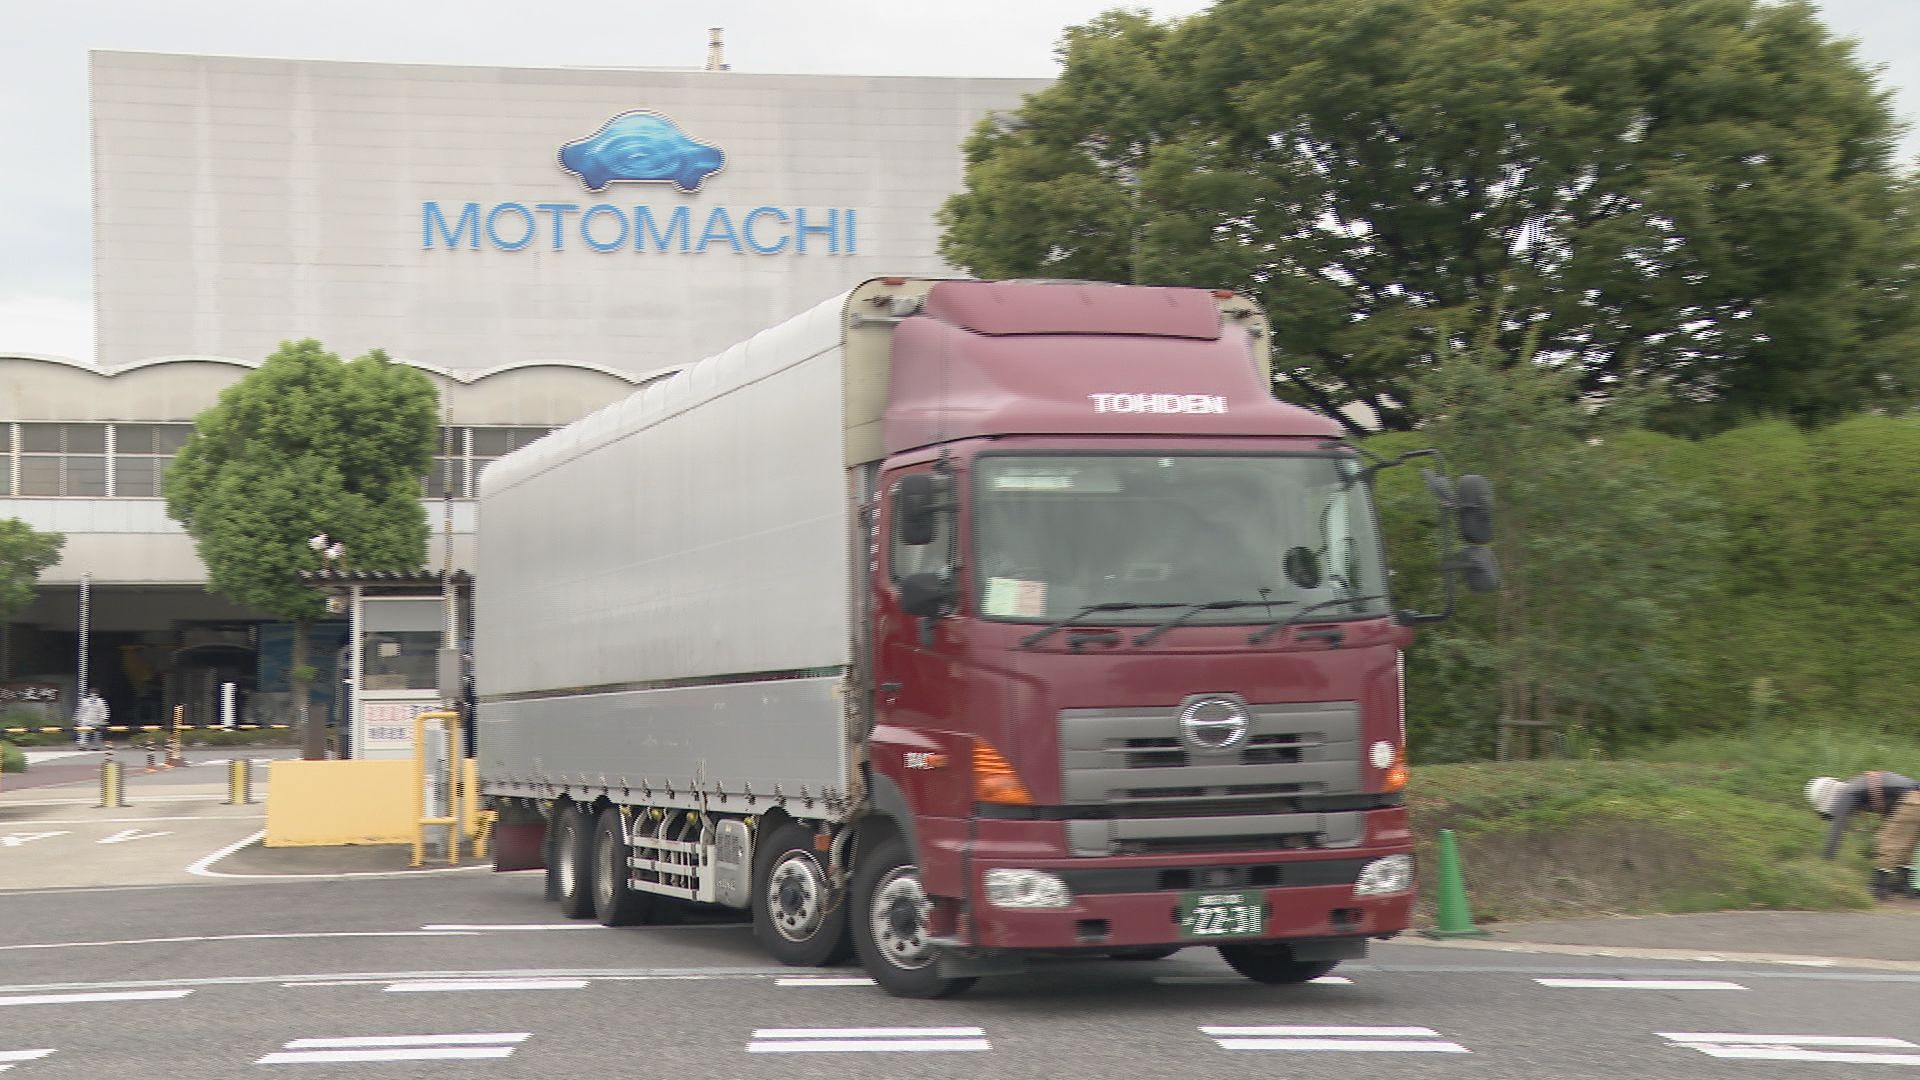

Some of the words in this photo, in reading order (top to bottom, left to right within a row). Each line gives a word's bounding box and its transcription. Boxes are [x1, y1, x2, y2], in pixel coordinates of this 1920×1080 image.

[421, 201, 857, 255] MOTOMACHI
[1088, 393, 1229, 414] TOHDEN
[1192, 905, 1261, 935] 22-31
